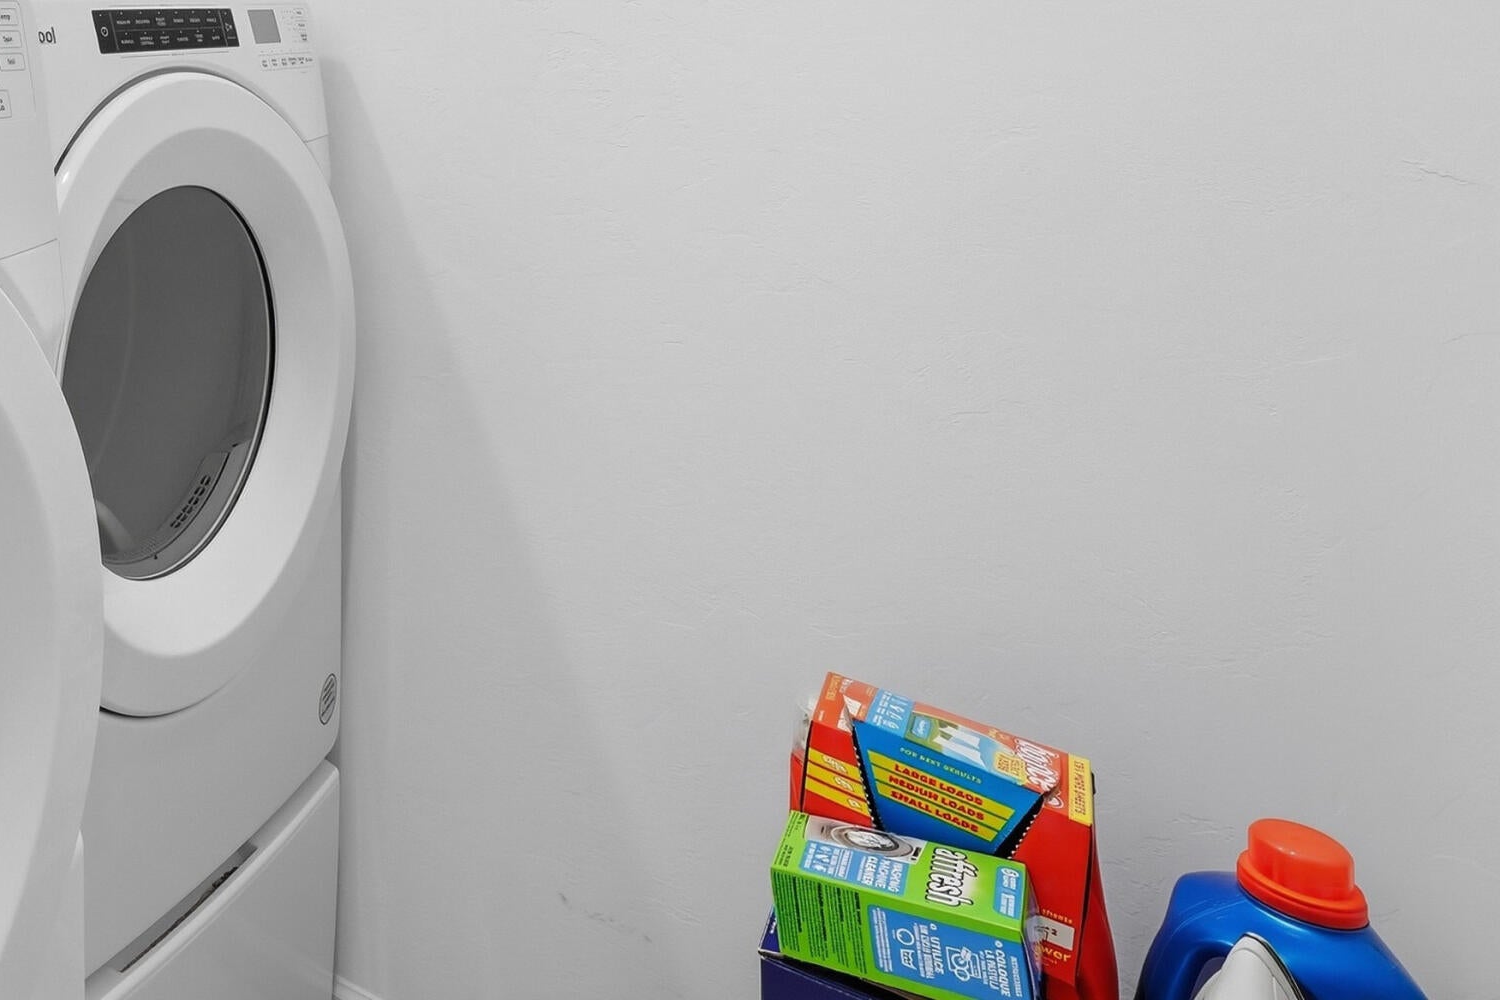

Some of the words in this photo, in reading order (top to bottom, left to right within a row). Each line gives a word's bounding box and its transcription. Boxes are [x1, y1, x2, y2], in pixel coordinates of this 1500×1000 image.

[38, 27, 57, 44] ool
[888, 775, 939, 801] MEDIUM
[941, 796, 985, 821] LOADS
[894, 763, 938, 787] LARGE
[938, 781, 983, 806] LOADS
[890, 790, 933, 814] SMALL
[935, 809, 979, 833] LOADS
[925, 847, 978, 907] affresh
